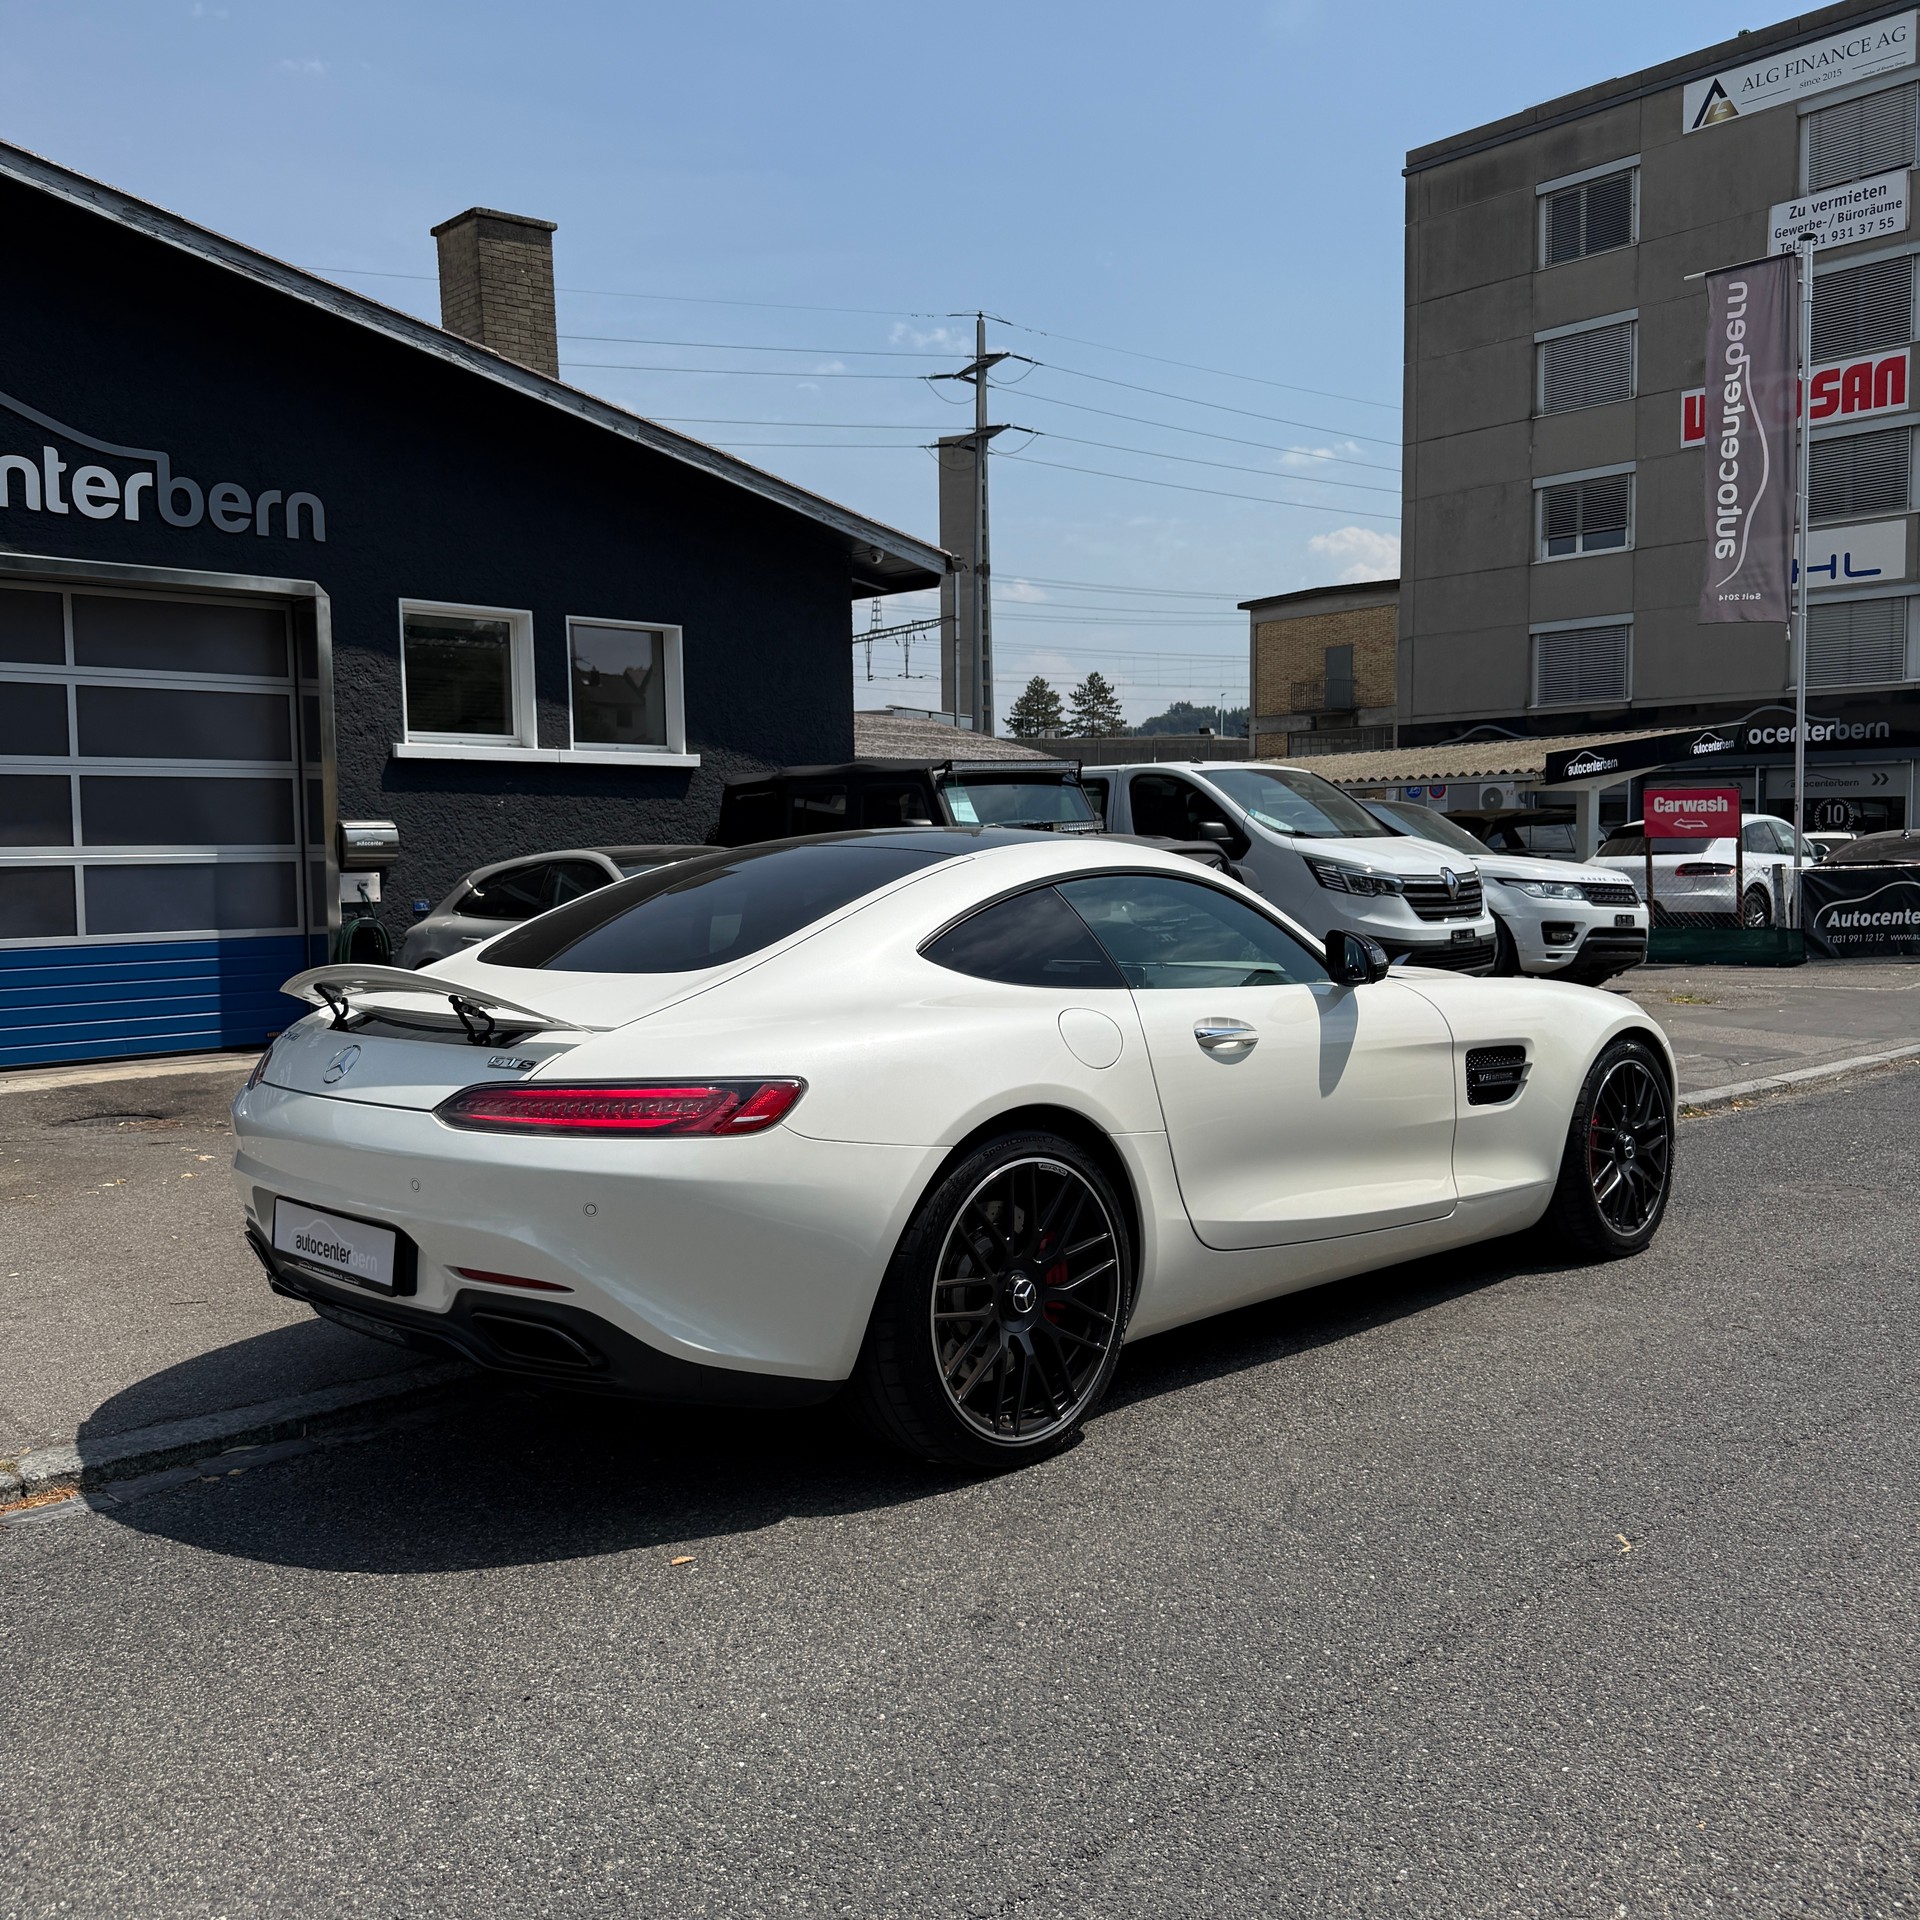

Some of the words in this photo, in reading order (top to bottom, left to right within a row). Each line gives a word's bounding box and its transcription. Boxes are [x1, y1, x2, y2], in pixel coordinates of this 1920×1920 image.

[1741, 67, 1779, 92] ALG
[1784, 37, 1872, 78] FINANCE
[1876, 25, 1907, 49] AG
[1799, 76, 1821, 89] since
[1822, 68, 1843, 82] 2015
[1789, 205, 1806, 220] Zu
[1811, 184, 1887, 214] vermieten
[1837, 199, 1903, 224] Büroräume
[1831, 226, 1854, 242] 931
[1858, 221, 1874, 235] 37
[1878, 216, 1895, 230] 55
[1692, 738, 1735, 755] autocenterbern
[1567, 757, 1618, 776] autocenterbern
[1790, 780, 1860, 788] aocenterbern
[1653, 796, 1728, 813] Carwash
[1826, 804, 1844, 824] 10
[1826, 908, 1920, 928] Autocente
[1832, 934, 1847, 944] 031
[1848, 933, 1863, 943] 991
[1864, 933, 1875, 942] 12
[1875, 932, 1885, 942] 12
[295, 1232, 378, 1274] autocenterbern
